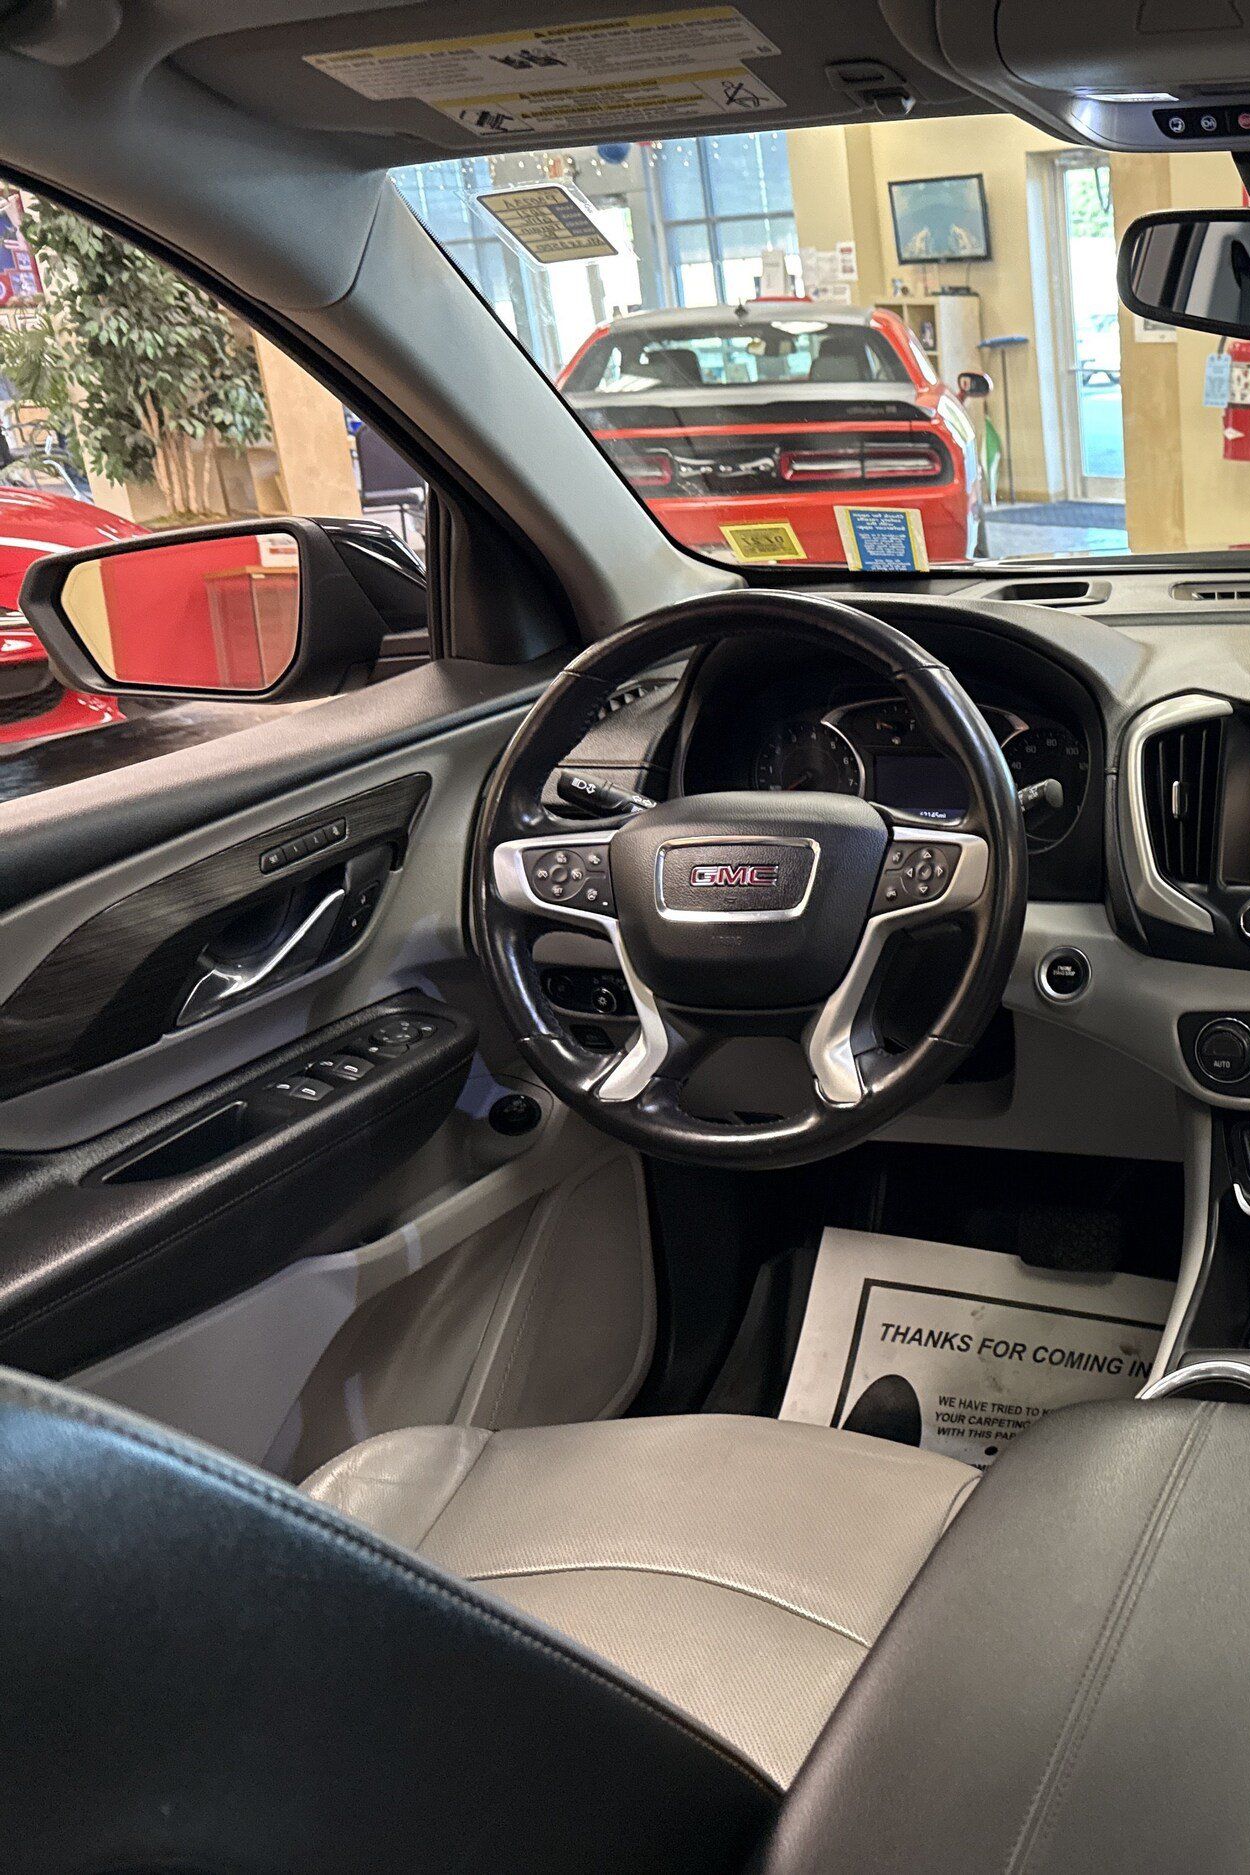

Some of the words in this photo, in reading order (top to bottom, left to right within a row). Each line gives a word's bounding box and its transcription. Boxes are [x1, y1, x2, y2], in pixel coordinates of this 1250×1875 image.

[691, 865, 779, 887] GMC
[1213, 1060, 1231, 1069] AUTO
[880, 1323, 973, 1353] THANKS
[978, 1337, 1027, 1362] FOR
[1032, 1346, 1123, 1375] COMING
[1128, 1360, 1153, 1379] IN
[938, 1395, 957, 1408] WE
[958, 1398, 989, 1412] HAVE
[991, 1403, 1023, 1416] TRIED
[1025, 1407, 1040, 1417] TO
[935, 1412, 966, 1424] YOUR
[937, 1427, 965, 1438] WITH
[968, 1429, 992, 1440] THIS
